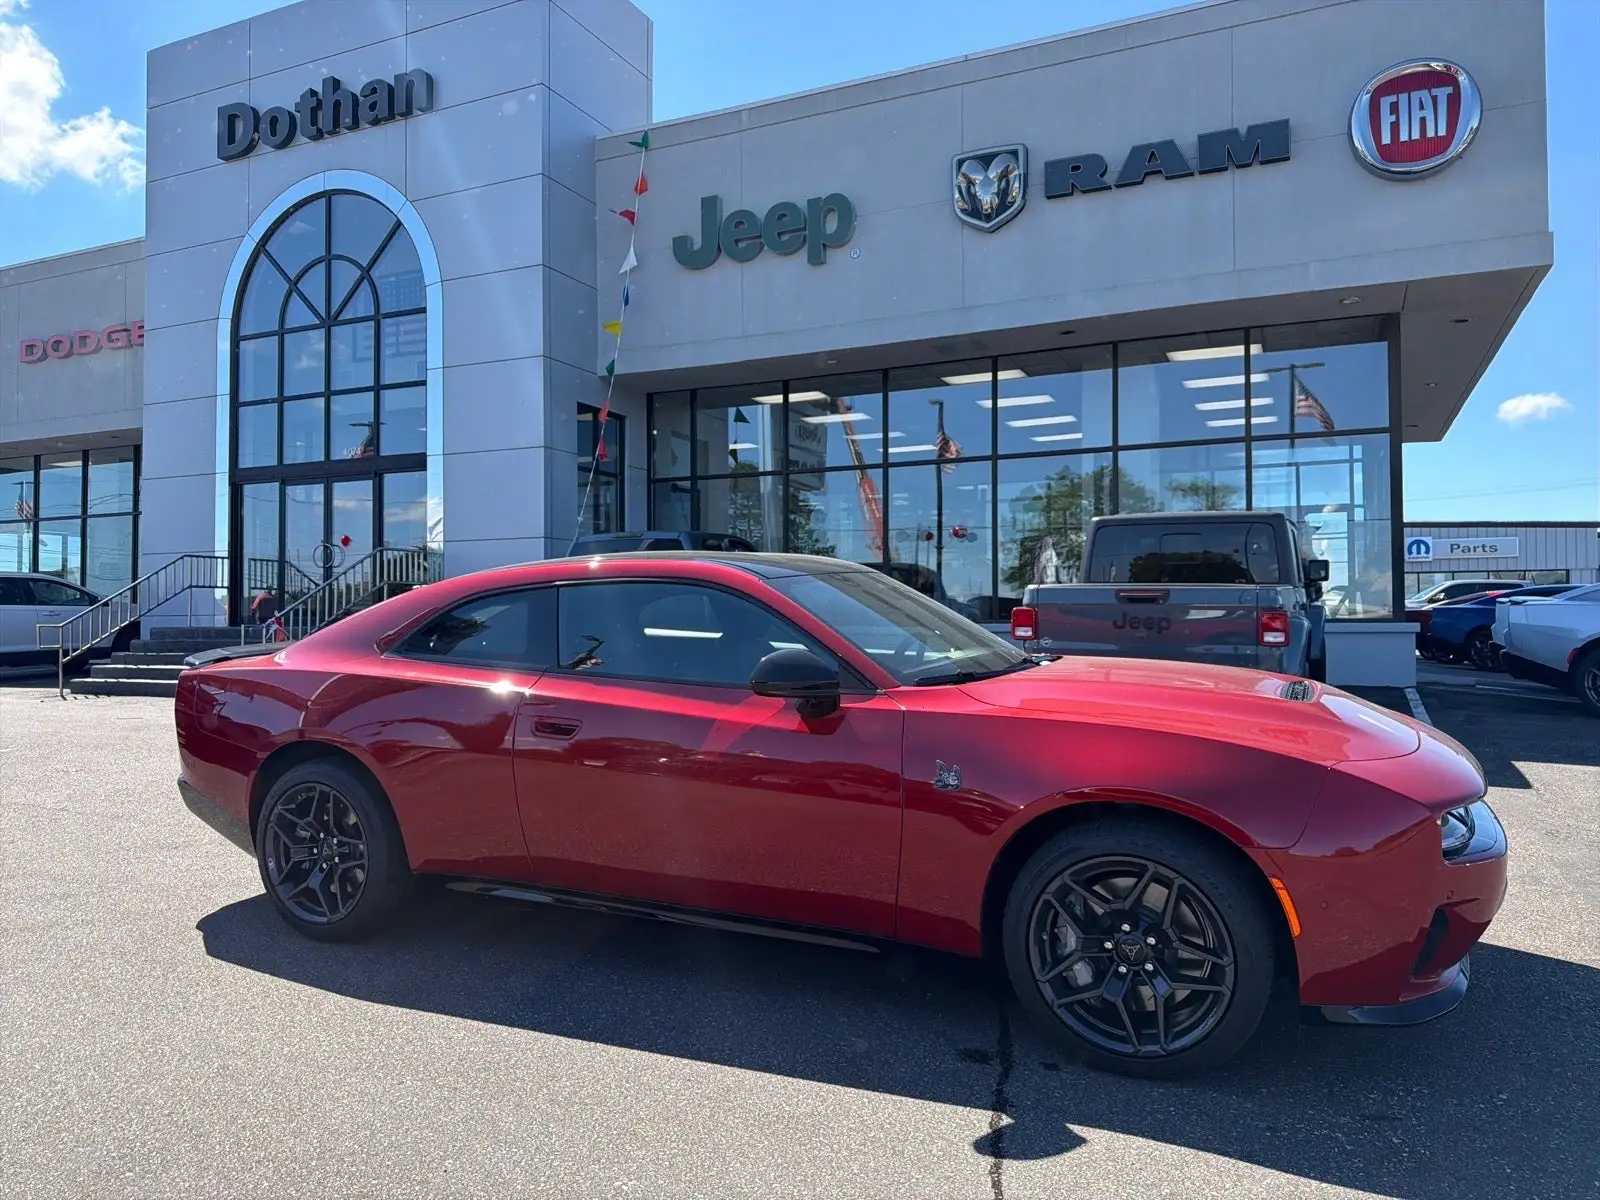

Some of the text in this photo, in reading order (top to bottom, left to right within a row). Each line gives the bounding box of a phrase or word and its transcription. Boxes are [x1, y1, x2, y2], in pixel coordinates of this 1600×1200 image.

[217, 68, 434, 161] Dothan
[1380, 86, 1454, 145] FIAT
[1045, 118, 1291, 199] RAM
[672, 192, 857, 270] Jeep
[1450, 543, 1498, 554] Parts
[1112, 611, 1172, 634] Jeep
